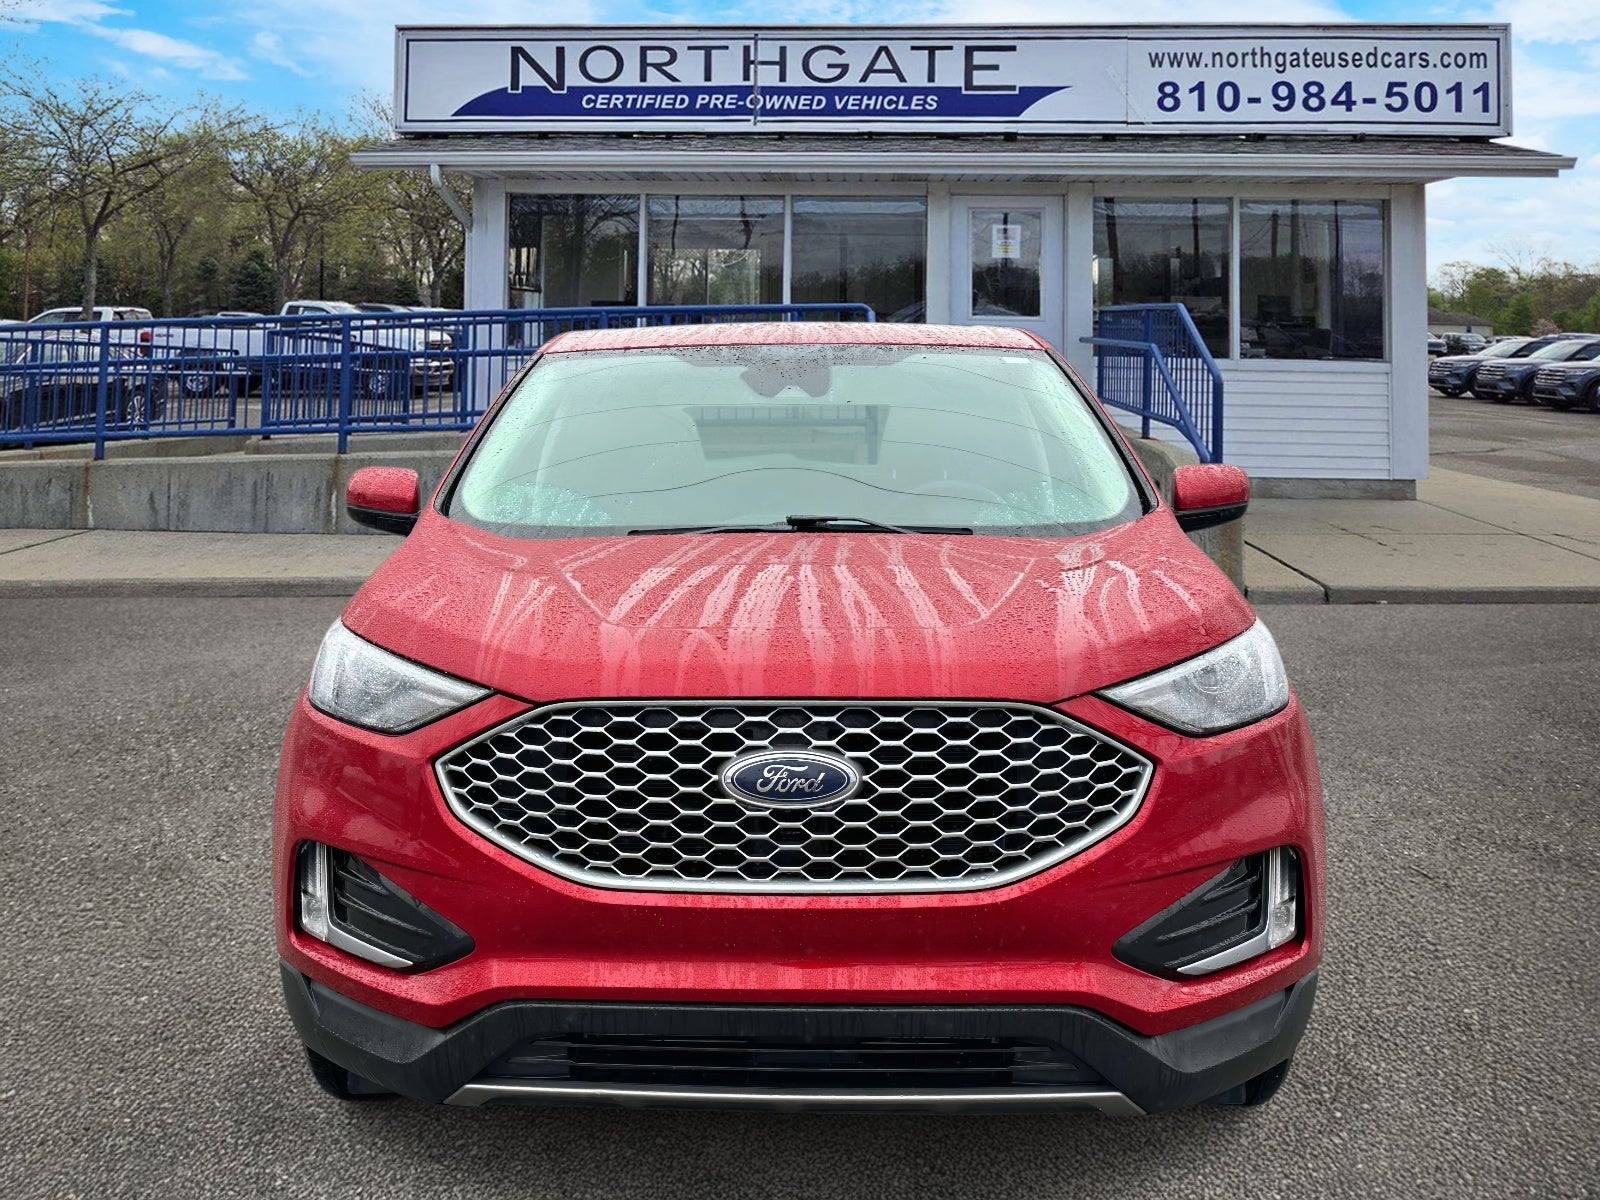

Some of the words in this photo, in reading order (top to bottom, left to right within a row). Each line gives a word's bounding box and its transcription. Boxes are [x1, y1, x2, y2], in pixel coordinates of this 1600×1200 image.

[509, 45, 1017, 94] NORTHGATE
[1149, 46, 1488, 73] www.northgateusedcars.com
[581, 94, 690, 109] CERTIFIED
[695, 94, 827, 110] PRE-OWNED
[834, 95, 938, 110] VEHICLES
[1156, 81, 1492, 113] 810-984-5011
[756, 764, 826, 793] Ford
